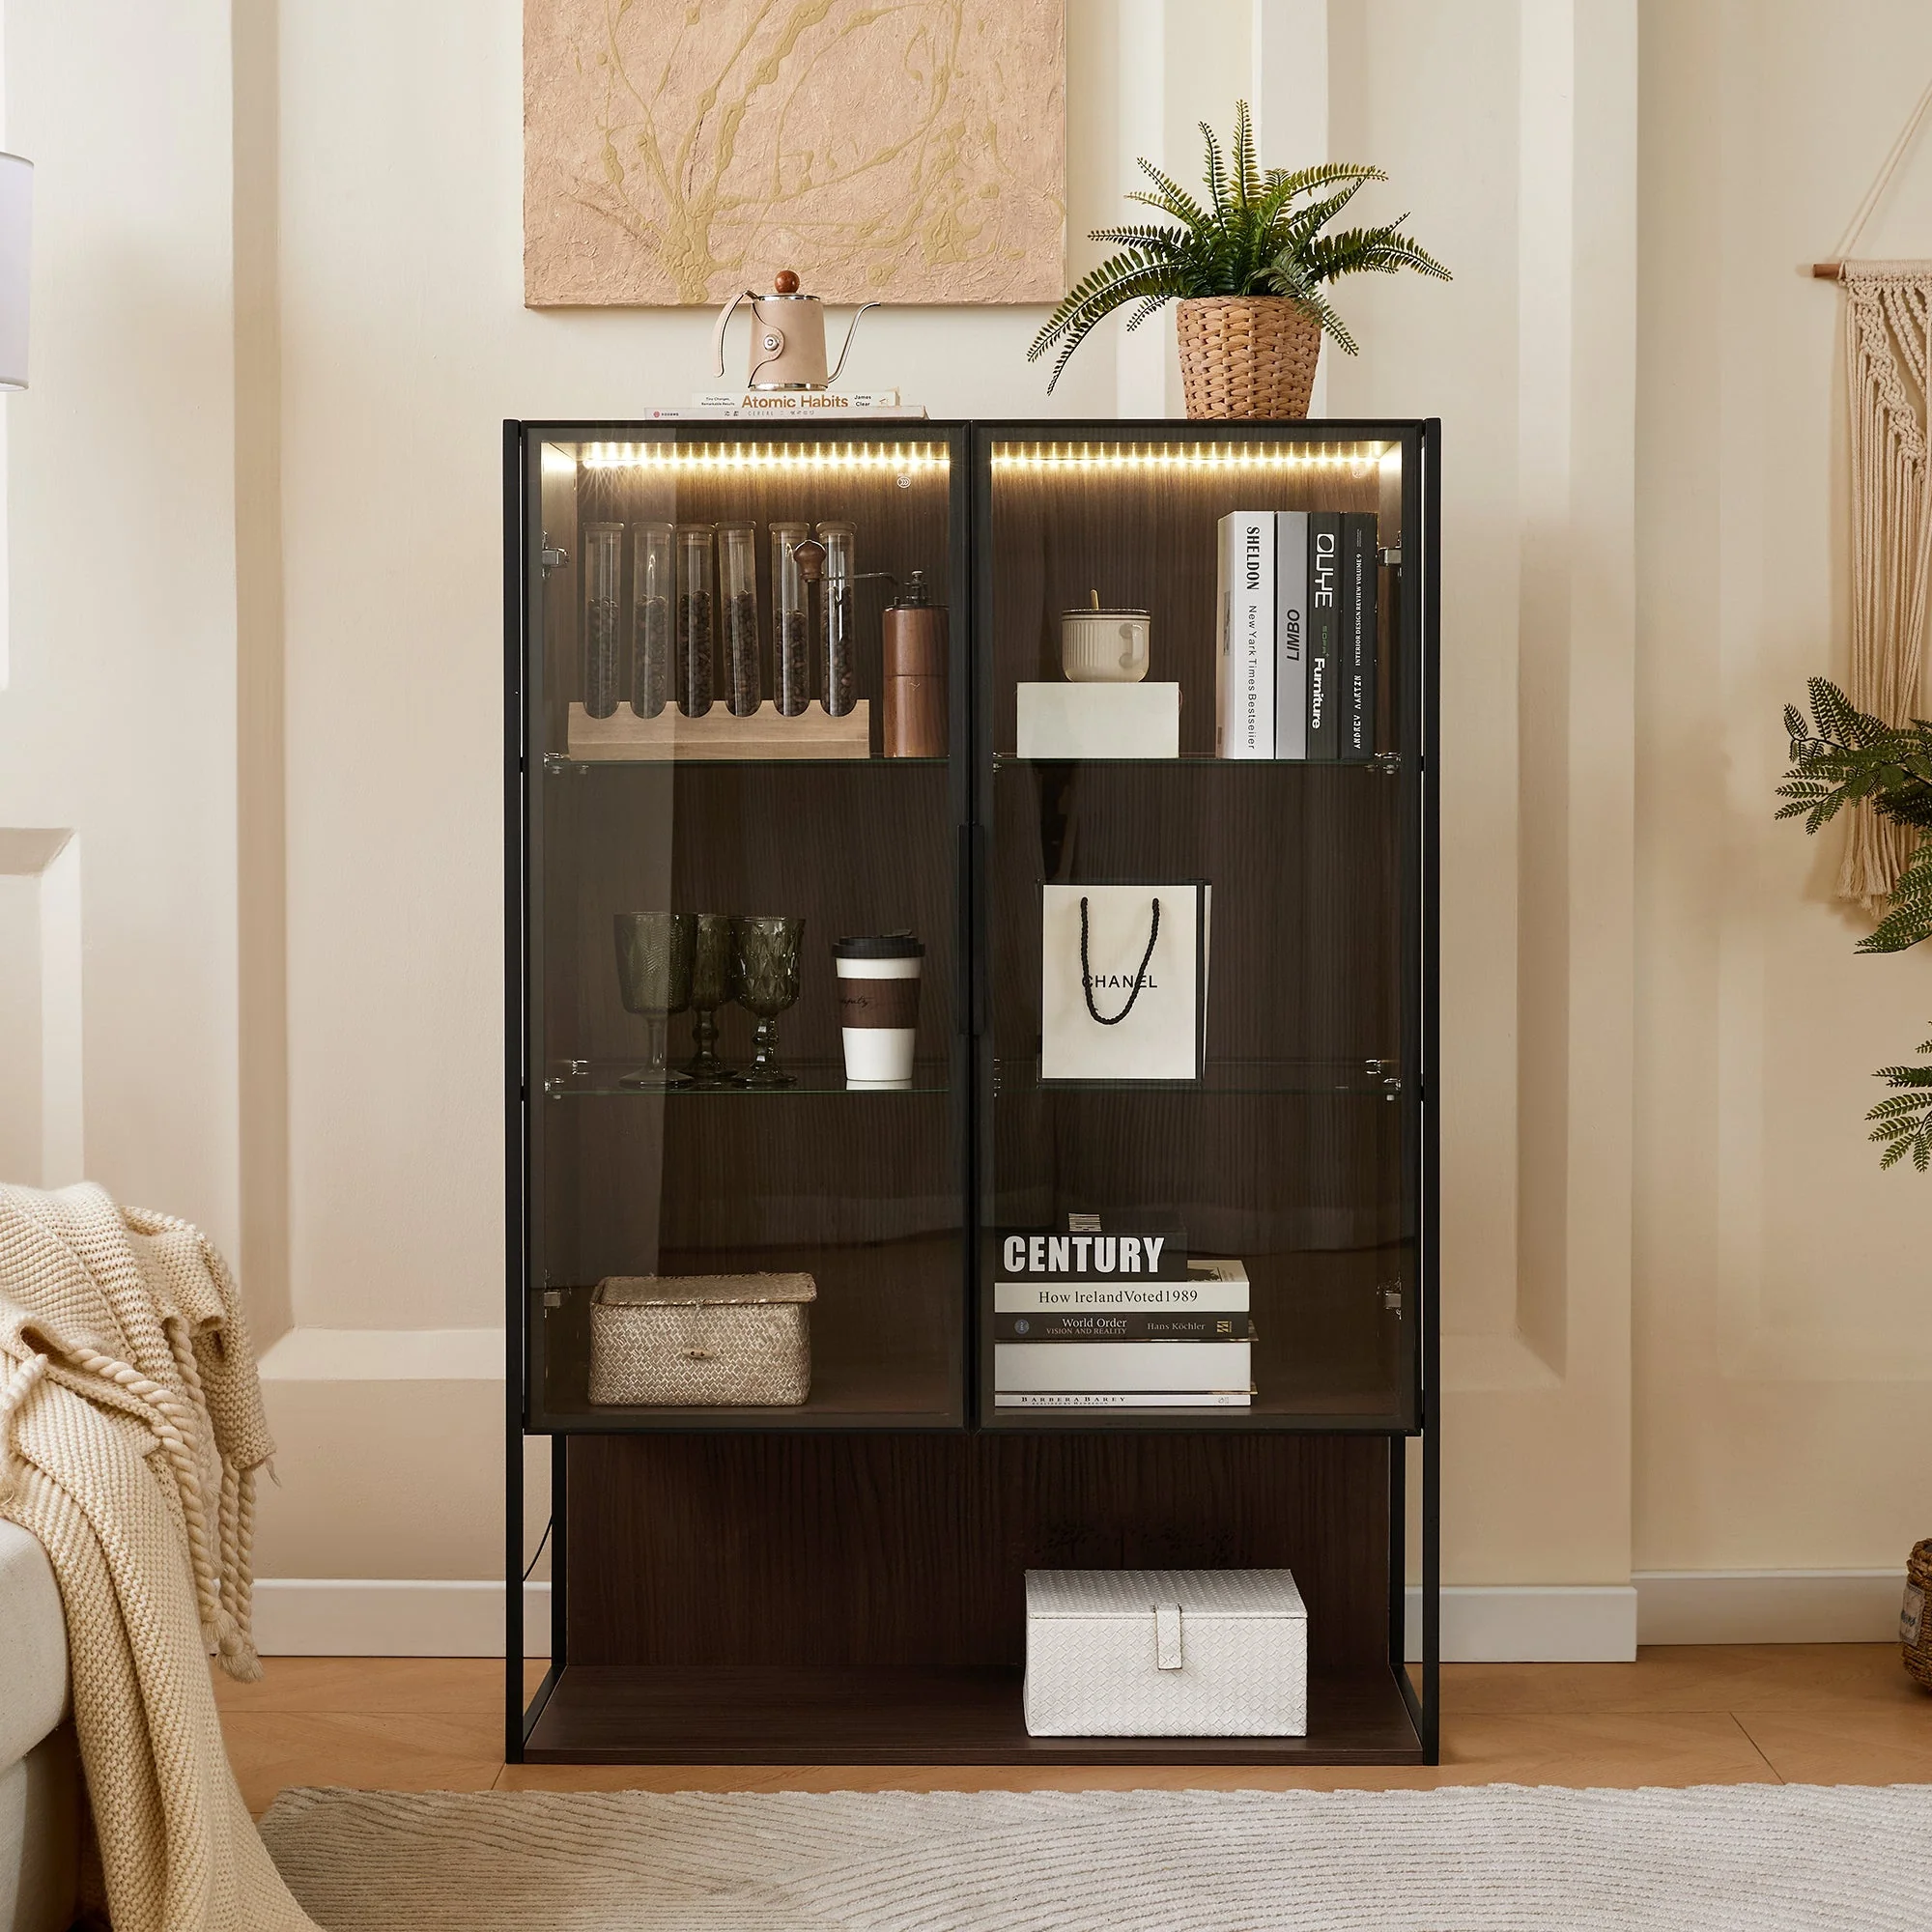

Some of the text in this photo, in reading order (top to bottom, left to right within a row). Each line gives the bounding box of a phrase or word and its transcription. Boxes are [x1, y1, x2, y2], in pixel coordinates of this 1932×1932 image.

[742, 395, 848, 409] Atomic Habits
[1246, 526, 1260, 590] SHELDON
[1315, 533, 1334, 608] OUYE
[1286, 609, 1300, 661] LIMBO
[1248, 658, 1257, 692] Times
[1312, 658, 1325, 729] Furniture
[1082, 975, 1158, 988] CHANEL
[1003, 1236, 1165, 1273] CENTURY
[1039, 1291, 1070, 1304] How
[1063, 1318, 1126, 1328] World Order
[1148, 1321, 1206, 1331] Hans Köchler
